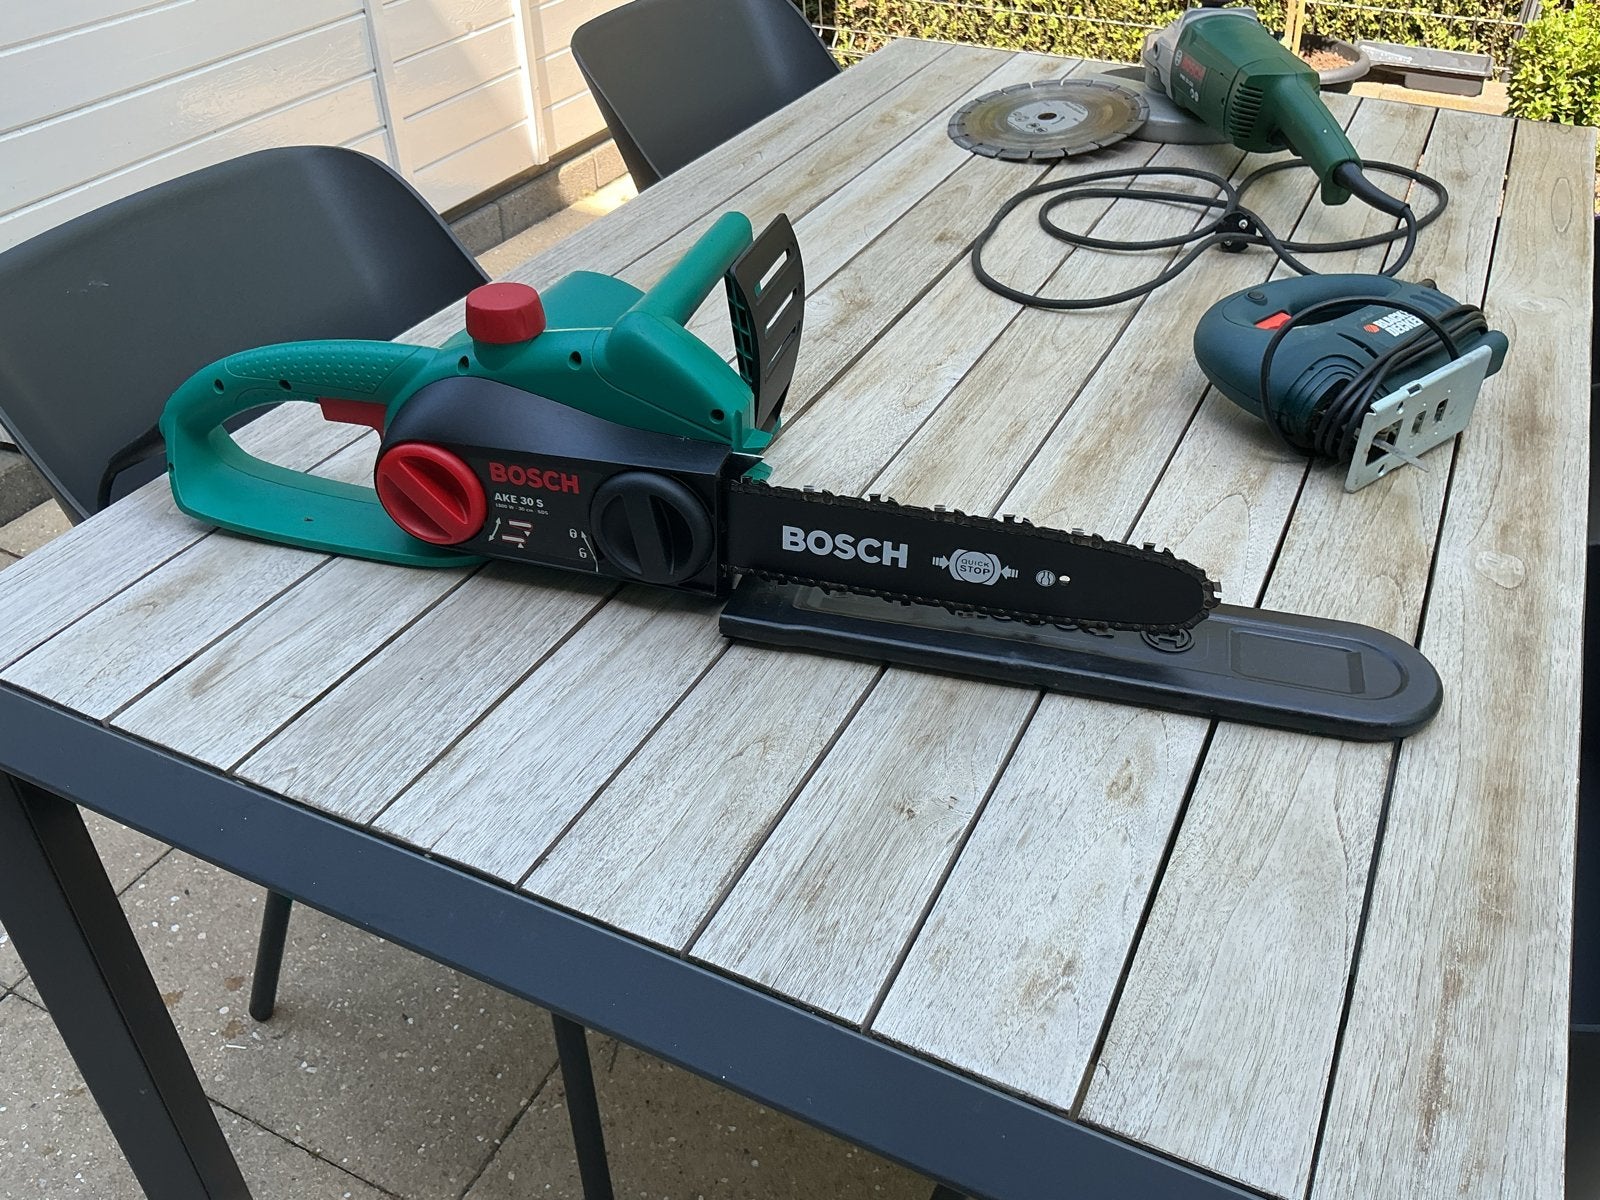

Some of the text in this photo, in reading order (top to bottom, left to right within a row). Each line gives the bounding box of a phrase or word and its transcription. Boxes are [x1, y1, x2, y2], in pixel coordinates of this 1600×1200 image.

[489, 462, 580, 494] BOSCH
[494, 492, 544, 508] AKE 30 S
[782, 525, 909, 569] BOSCH
[959, 564, 991, 576] STOP
[961, 558, 990, 568] QUICK
